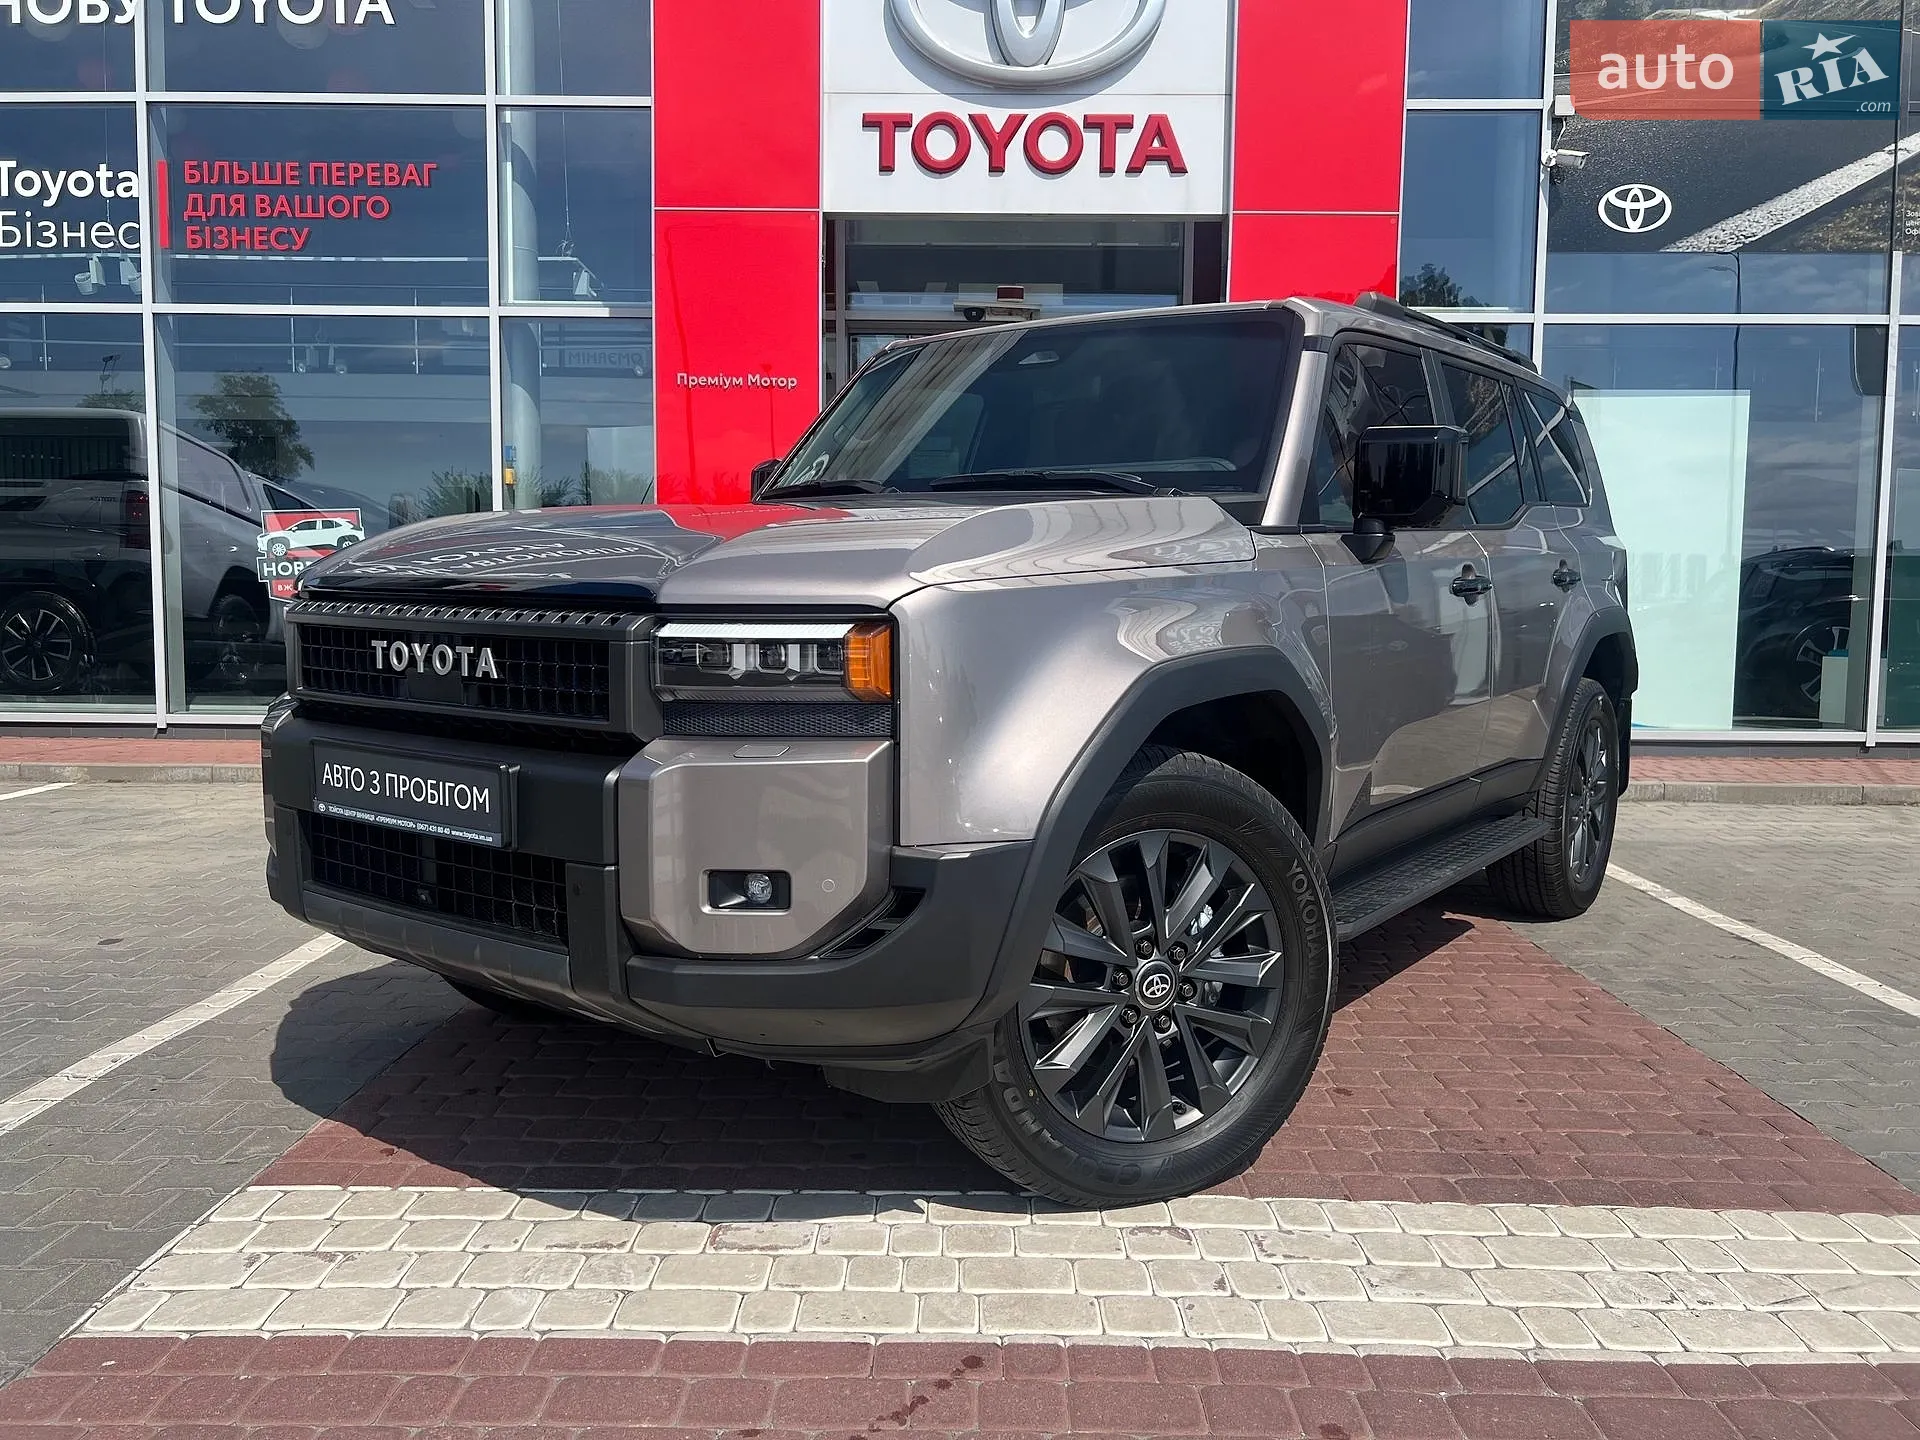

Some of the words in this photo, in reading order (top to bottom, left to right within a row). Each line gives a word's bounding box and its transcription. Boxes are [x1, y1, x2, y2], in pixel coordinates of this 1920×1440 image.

[862, 111, 1189, 175] TOYOTA
[0, 160, 140, 207] Toyota
[184, 160, 301, 186] БІЛЬШЕ
[308, 163, 438, 188] ПЕРЕВАГ
[183, 193, 246, 222] ДЛЯ
[255, 195, 391, 220] ВАШОГО
[0, 210, 140, 249] Бізнес
[186, 226, 311, 252] БІЗНЕСУ
[677, 372, 743, 389] Преміум
[747, 373, 798, 390] Мотор
[371, 640, 498, 679] TOYOTA
[322, 762, 365, 792] АВТО
[385, 772, 491, 814] ПРОБІГОМ
